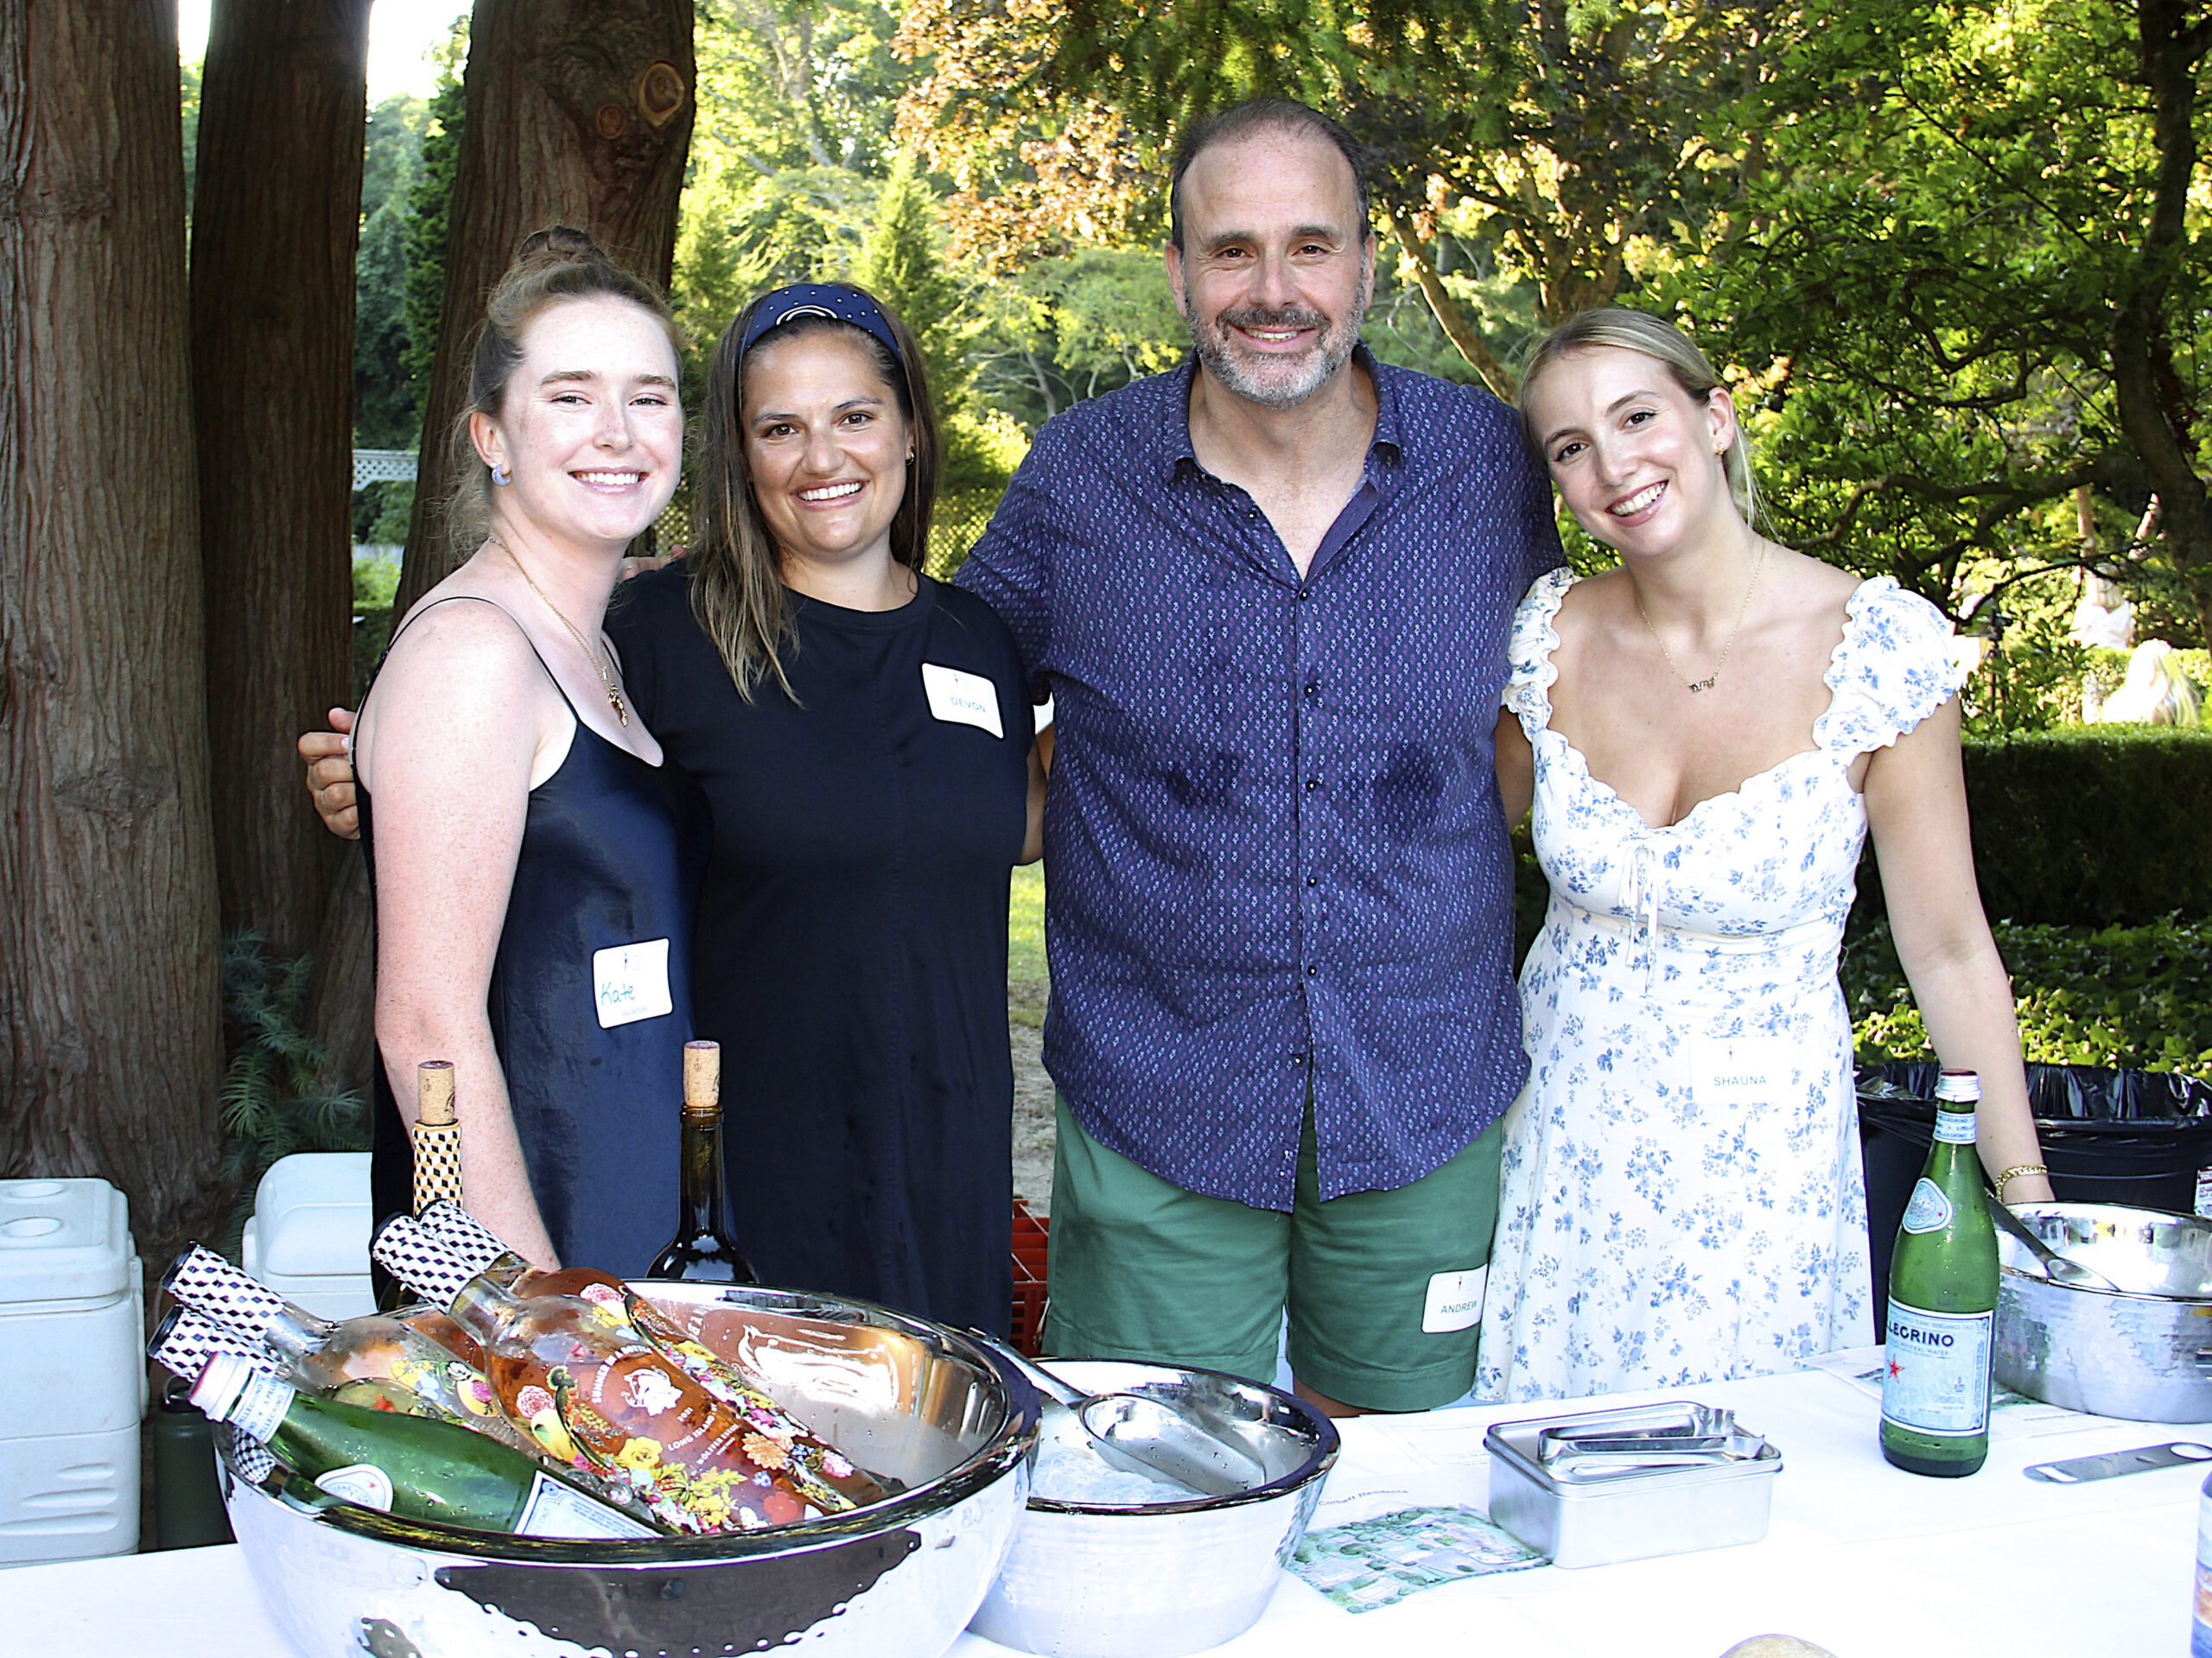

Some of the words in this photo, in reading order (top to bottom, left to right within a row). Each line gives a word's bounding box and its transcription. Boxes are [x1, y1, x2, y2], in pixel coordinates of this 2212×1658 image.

[950, 696, 986, 713] DEVON
[601, 981, 635, 1006] Kate
[1713, 1075, 1767, 1086] SHAUNA
[1440, 1299, 1478, 1314] ANDREW
[591, 1364, 610, 1404] SUMMER
[605, 1354, 618, 1367] IN
[614, 1350, 624, 1360] A
[677, 1406, 694, 1422] 2021
[667, 1436, 695, 1452] LONG
[692, 1414, 715, 1439] ISLAND
[1318, 1496, 1356, 1505] Corbett
